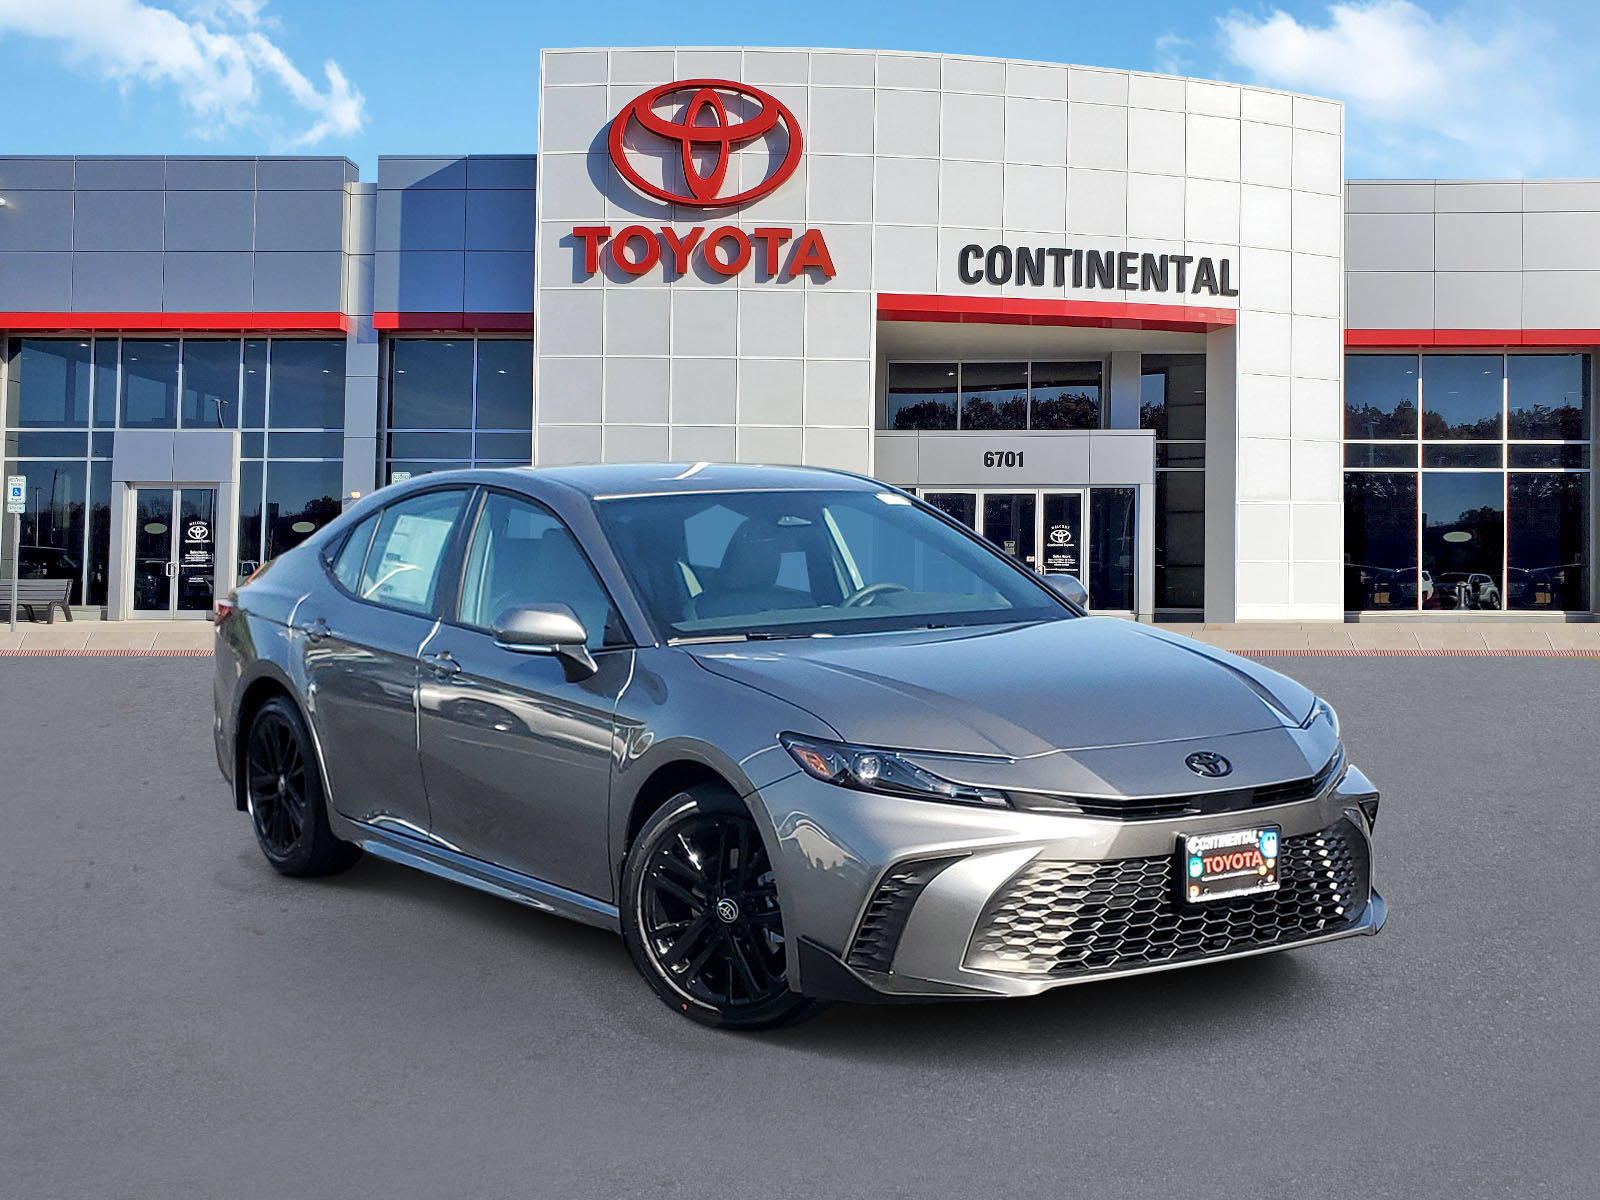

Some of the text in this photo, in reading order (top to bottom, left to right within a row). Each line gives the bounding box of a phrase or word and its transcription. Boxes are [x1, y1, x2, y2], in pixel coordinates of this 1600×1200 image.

[572, 225, 837, 277] TOYOTA
[959, 244, 1239, 297] CONTINENTAL
[983, 451, 1024, 468] 6701
[1203, 850, 1264, 874] TOYOTA
